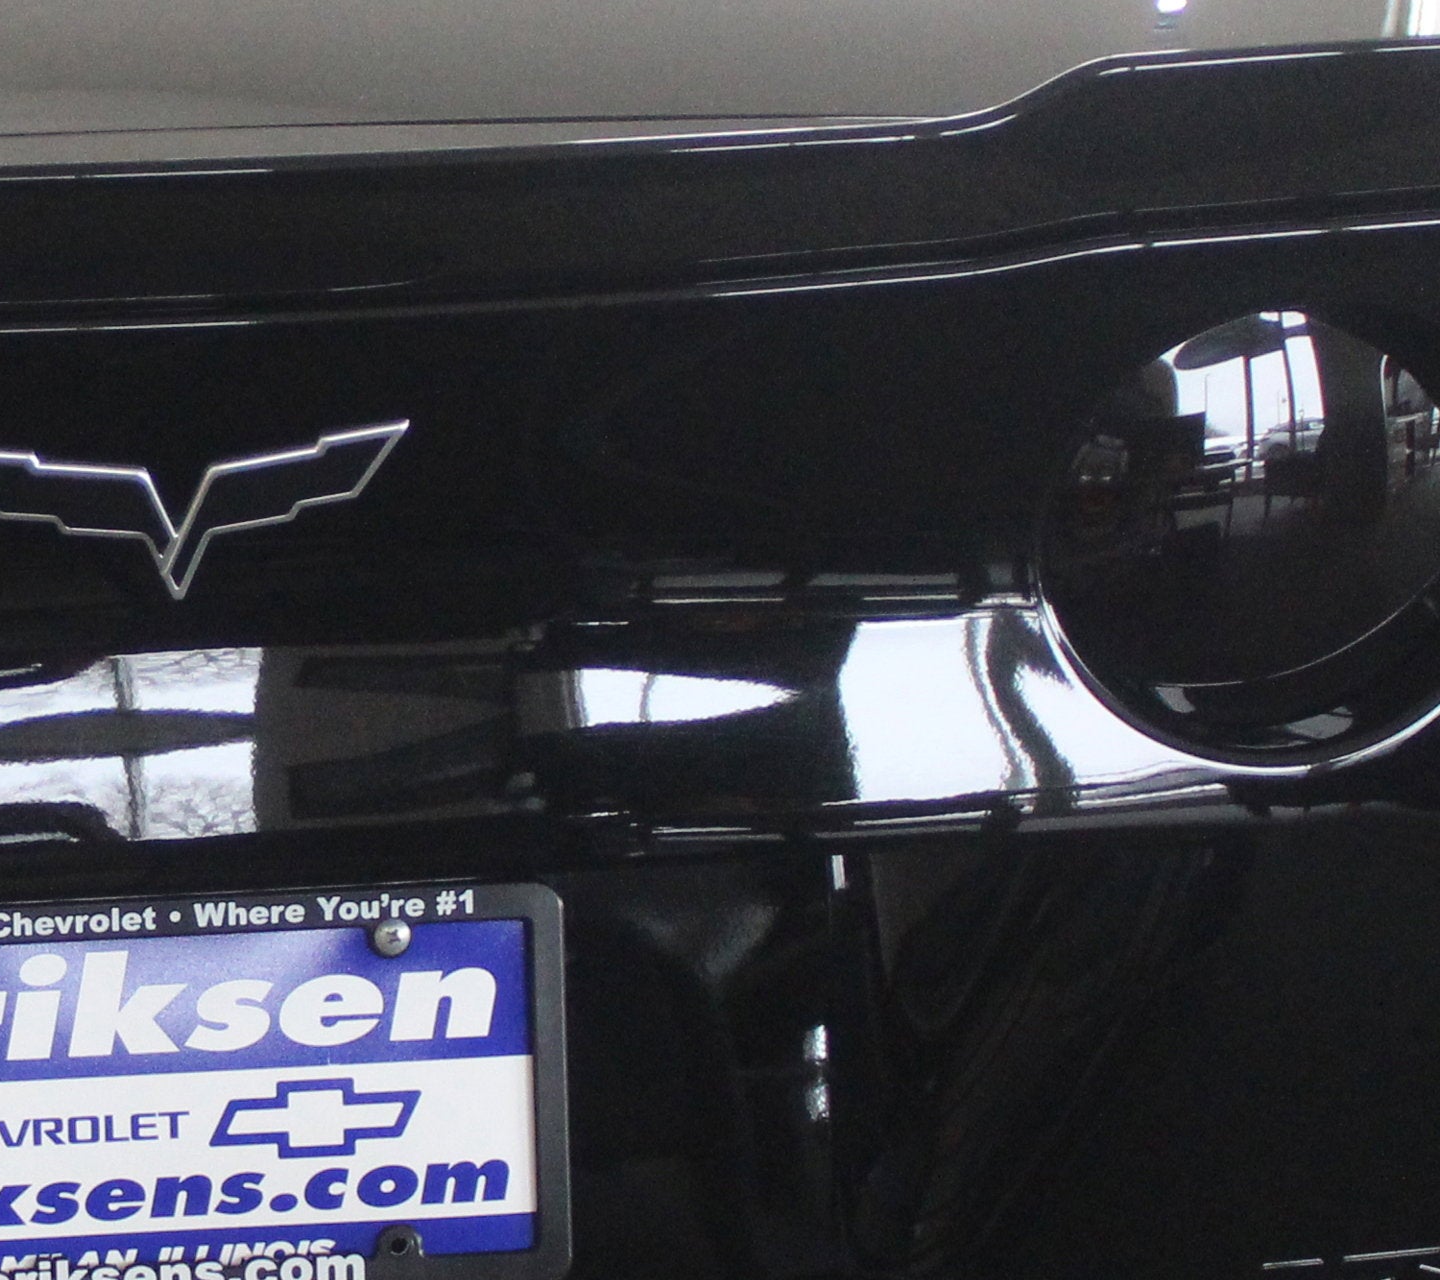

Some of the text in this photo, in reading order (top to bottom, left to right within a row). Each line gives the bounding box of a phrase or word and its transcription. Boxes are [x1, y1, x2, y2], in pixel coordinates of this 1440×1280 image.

[193, 902, 307, 928] Where
[316, 893, 426, 922] You're
[435, 889, 478, 916] #1
